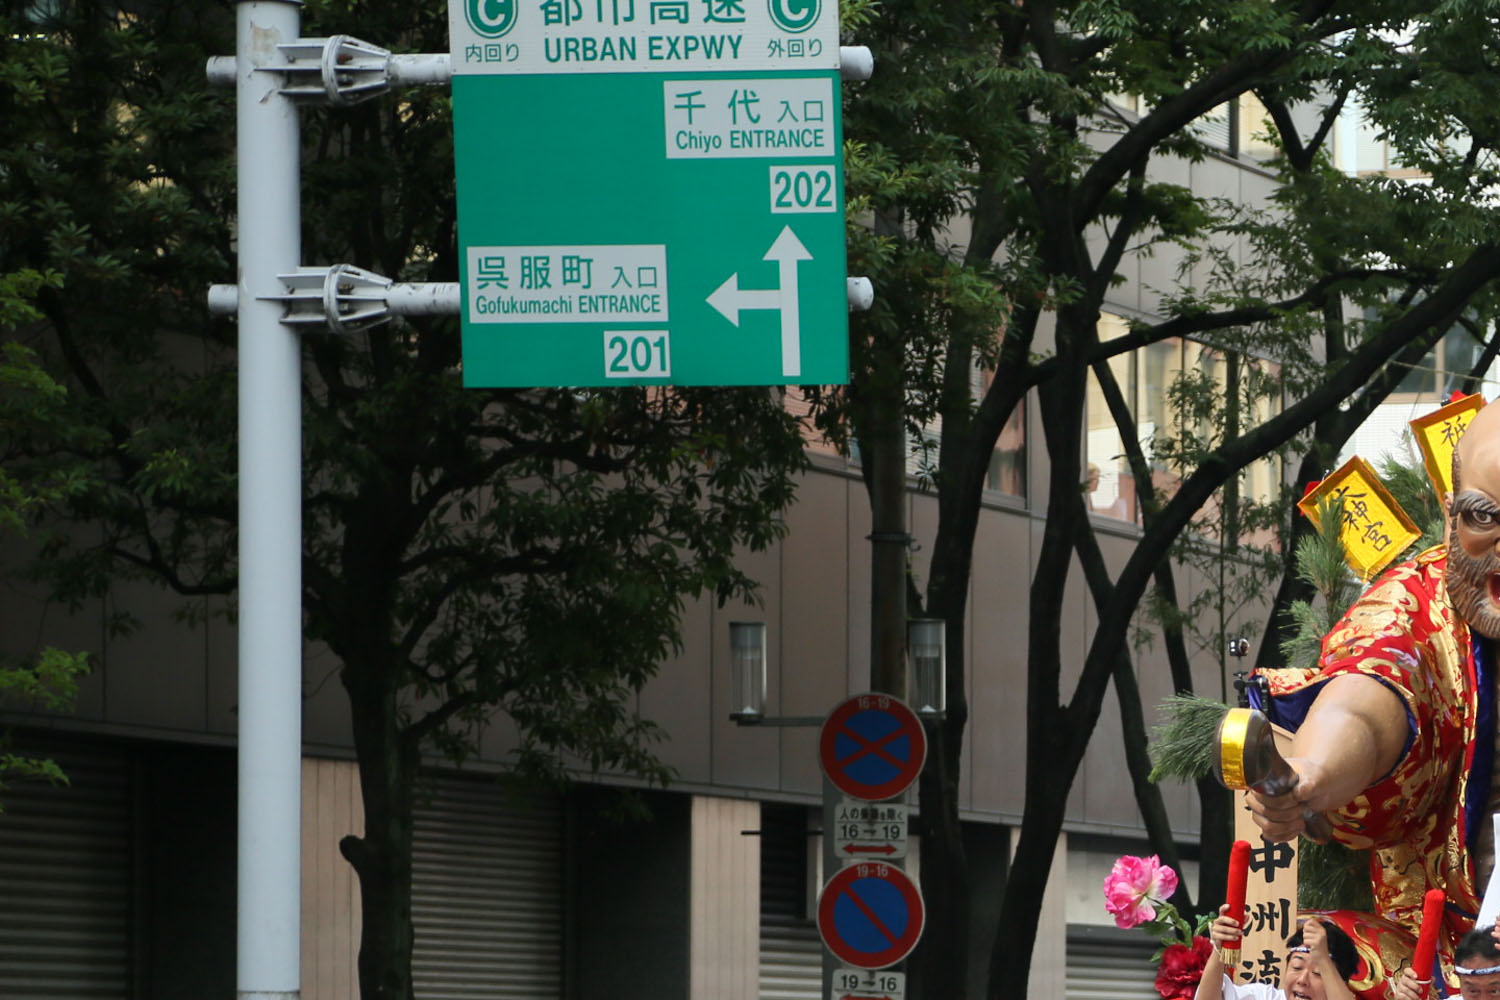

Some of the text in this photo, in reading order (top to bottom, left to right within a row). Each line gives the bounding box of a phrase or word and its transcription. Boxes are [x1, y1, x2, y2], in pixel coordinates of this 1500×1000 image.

[465, 43, 520, 63] 内回り
[544, 34, 743, 63] URBAN EXPWY
[767, 38, 823, 59] 外回り
[777, 100, 824, 124] 入口
[675, 129, 824, 152] Chiyo ENTRANCE
[774, 171, 832, 208] 202
[476, 255, 659, 290] 呉服町 入口
[476, 295, 661, 316] Gofukumachi ENTRANCE
[609, 336, 669, 373] 201
[842, 824, 900, 839] 16 19
[1242, 788, 1296, 988] 中洲流
[841, 974, 897, 991] 19 16
